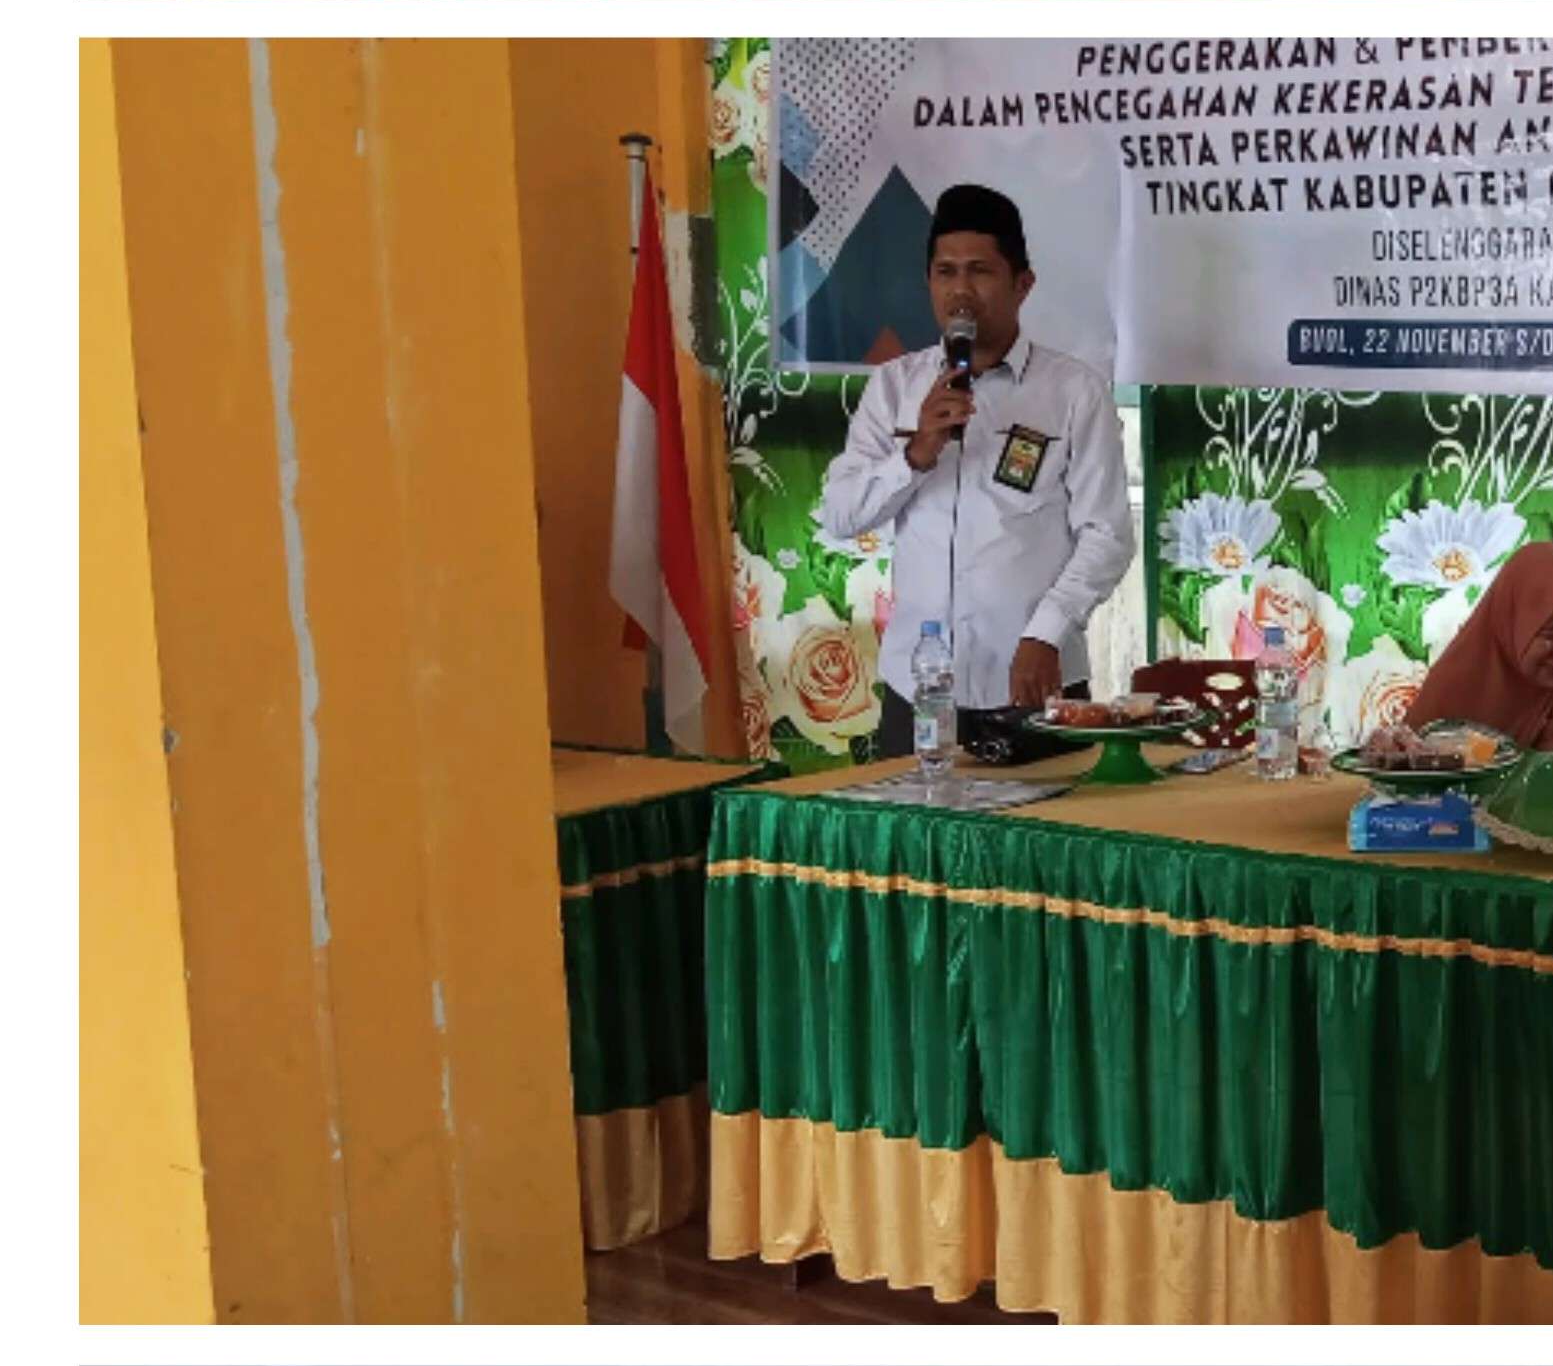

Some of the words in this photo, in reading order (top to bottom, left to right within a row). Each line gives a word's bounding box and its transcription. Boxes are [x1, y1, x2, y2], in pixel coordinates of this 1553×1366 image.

[1076, 37, 1336, 78] PENGGERAKAN
[1355, 37, 1379, 65] &
[914, 93, 1023, 128] DALAM
[1034, 85, 1258, 124] PENCEGAHAN
[1273, 71, 1493, 116] KEKERASAN
[1120, 131, 1219, 168] SERTA
[1232, 121, 1477, 163] PERKAWINAN
[1146, 178, 1288, 215] TINGKAT
[1305, 169, 1527, 212] KABUPATEN
[1334, 276, 1400, 308] DINAS
[1410, 275, 1518, 308] P2KBP3A
[1362, 328, 1388, 353] 22
[1396, 327, 1505, 356] NOVEMBER
[1515, 328, 1553, 356] S/D
